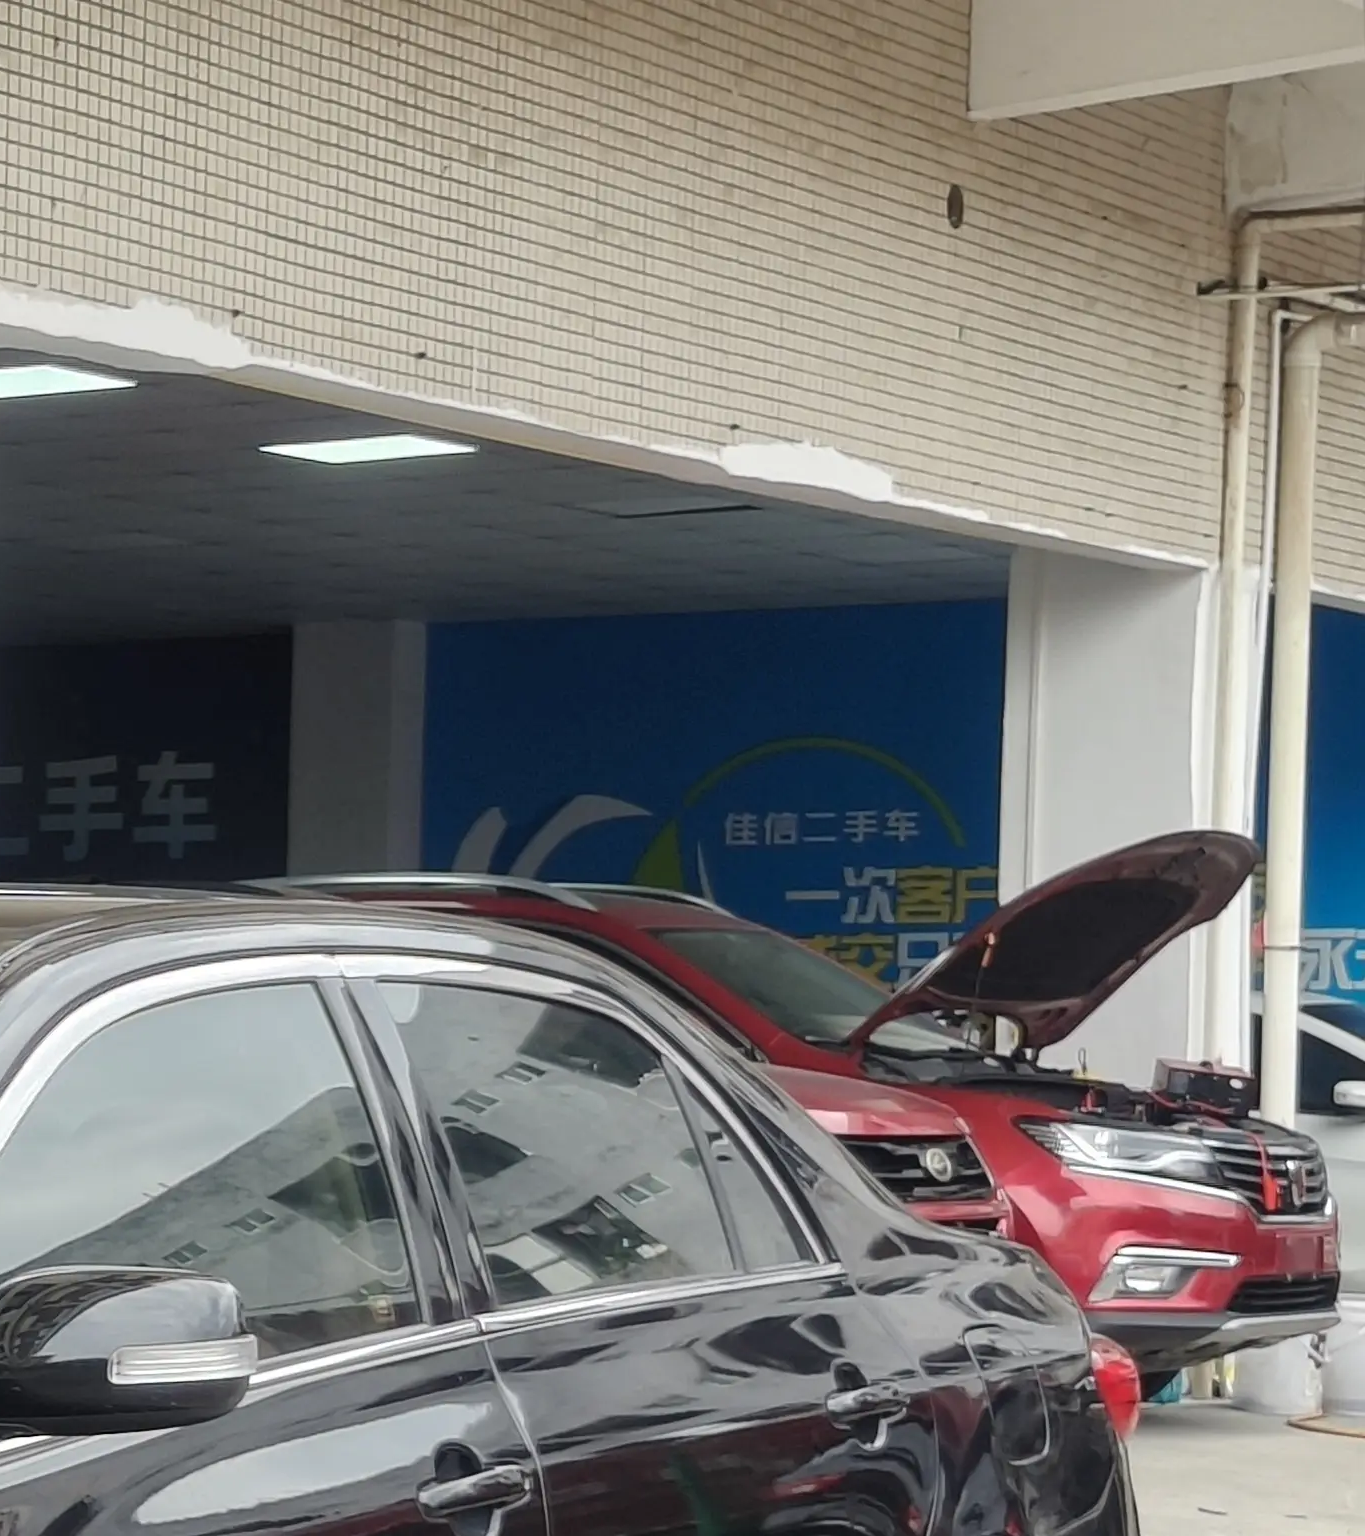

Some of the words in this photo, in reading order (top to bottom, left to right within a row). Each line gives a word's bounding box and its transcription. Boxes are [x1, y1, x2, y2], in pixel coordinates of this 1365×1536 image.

[724, 809, 921, 846] 佳信二手车
